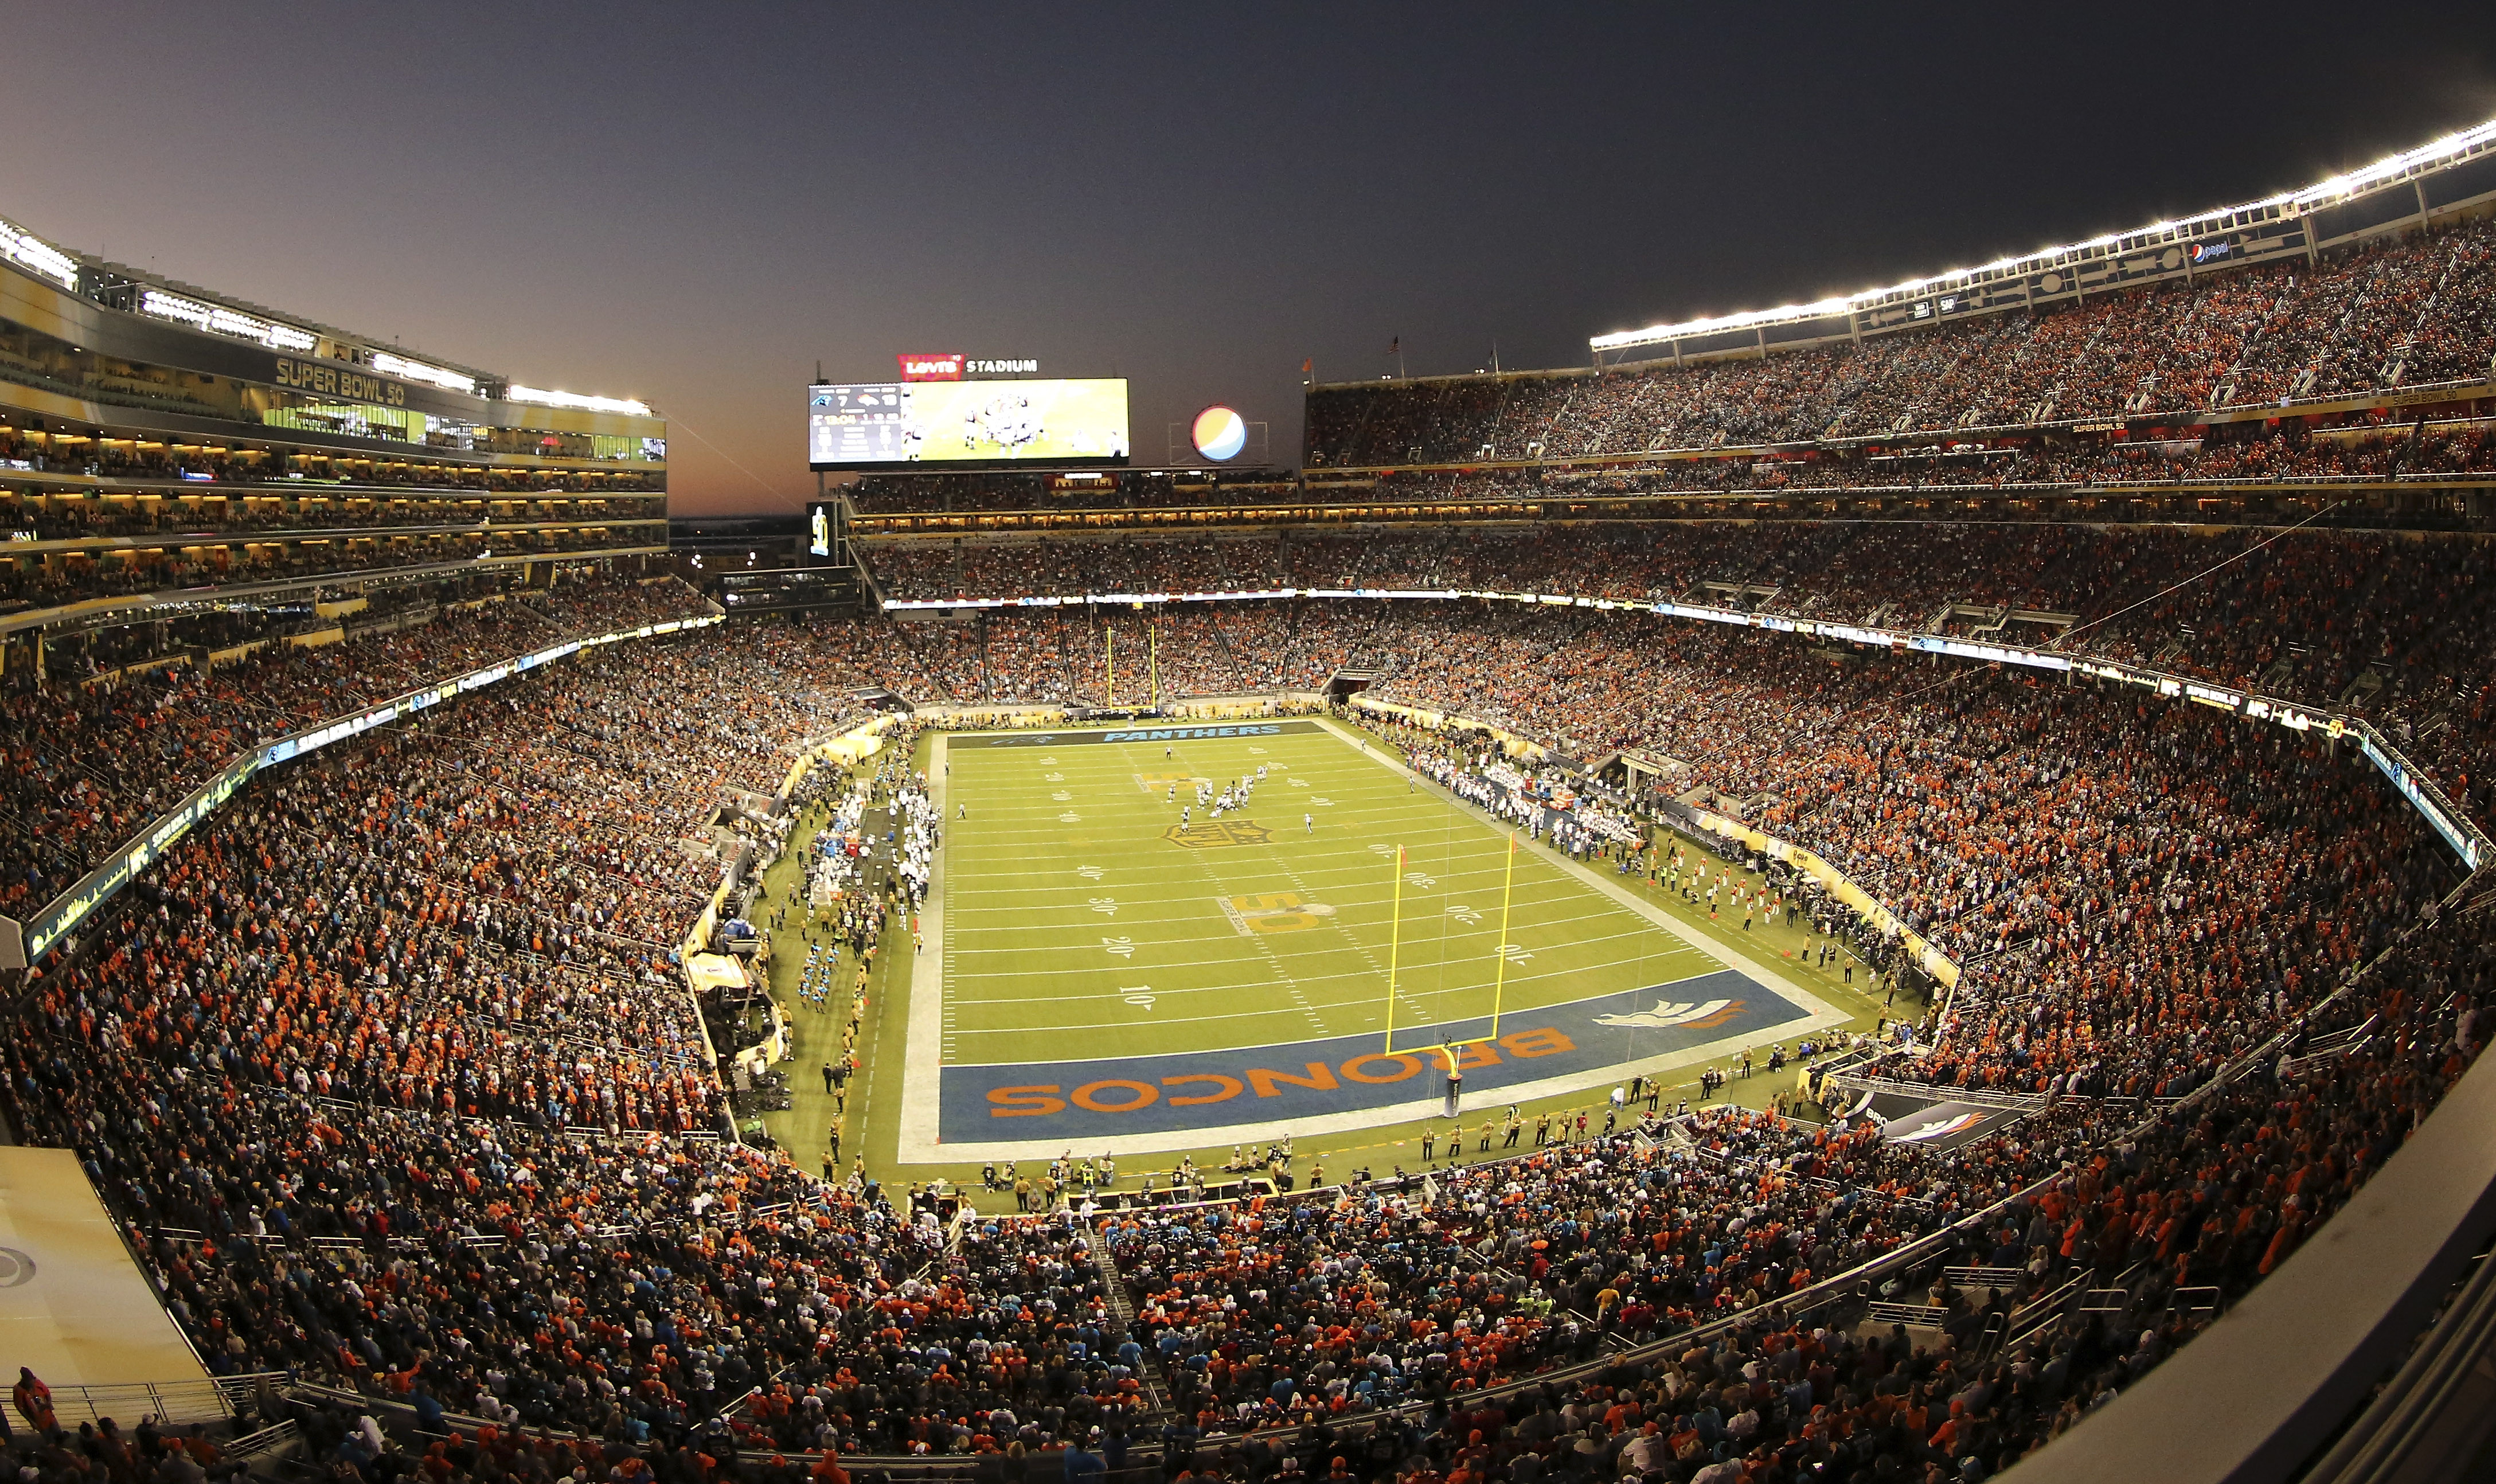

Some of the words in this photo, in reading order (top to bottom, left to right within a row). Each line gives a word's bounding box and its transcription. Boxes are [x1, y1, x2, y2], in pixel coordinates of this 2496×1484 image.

[2205, 241, 2228, 259] pepsi
[1940, 299, 1954, 310] SAP
[966, 359, 1037, 373] STADIUM
[276, 358, 336, 394] SUPER
[341, 372, 384, 403] BOWL
[387, 382, 404, 406] 50
[838, 396, 848, 407] 7
[2393, 395, 2419, 405] SUPER
[2421, 393, 2444, 402] BOWL
[2447, 390, 2457, 400] 50
[2073, 424, 2095, 432] SUPER
[2096, 423, 2115, 431] BOWL
[2246, 700, 2270, 719] AFC
[298, 728, 329, 752] SUPER
[329, 720, 353, 740] BOWL
[1104, 725, 1281, 742] PANTHERS
[2326, 720, 2344, 739] 50
[1077, 864, 1104, 877] 40
[1404, 872, 1436, 886] 30
[1088, 897, 1118, 912] 30
[1446, 905, 1483, 921] 20
[1220, 900, 1237, 916] SUPER
[1232, 917, 1248, 932] BOWL
[1102, 936, 1135, 954] 20
[1494, 944, 1534, 962] 10
[1119, 985, 1156, 1005] 10
[985, 1026, 1577, 1119] BRONCOS
[1866, 1106, 1892, 1126] BRO
